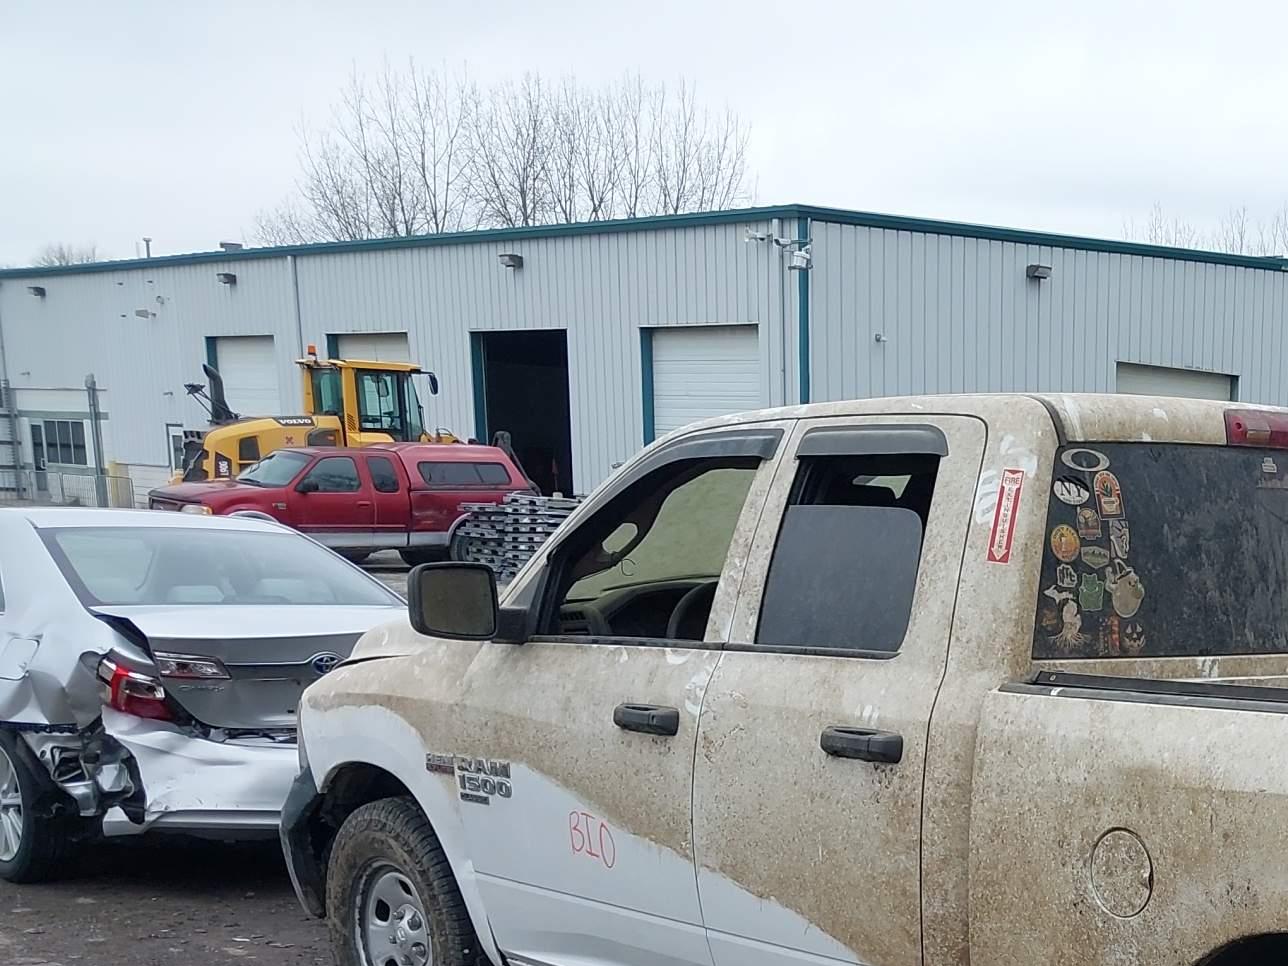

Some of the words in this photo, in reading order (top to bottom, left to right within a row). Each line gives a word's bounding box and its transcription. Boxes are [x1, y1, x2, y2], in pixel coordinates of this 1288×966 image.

[1004, 476, 1021, 485] FIRE
[1059, 480, 1083, 498] NY
[457, 757, 511, 779] RAM
[458, 774, 513, 798] 1500
[569, 811, 616, 869] BIO
